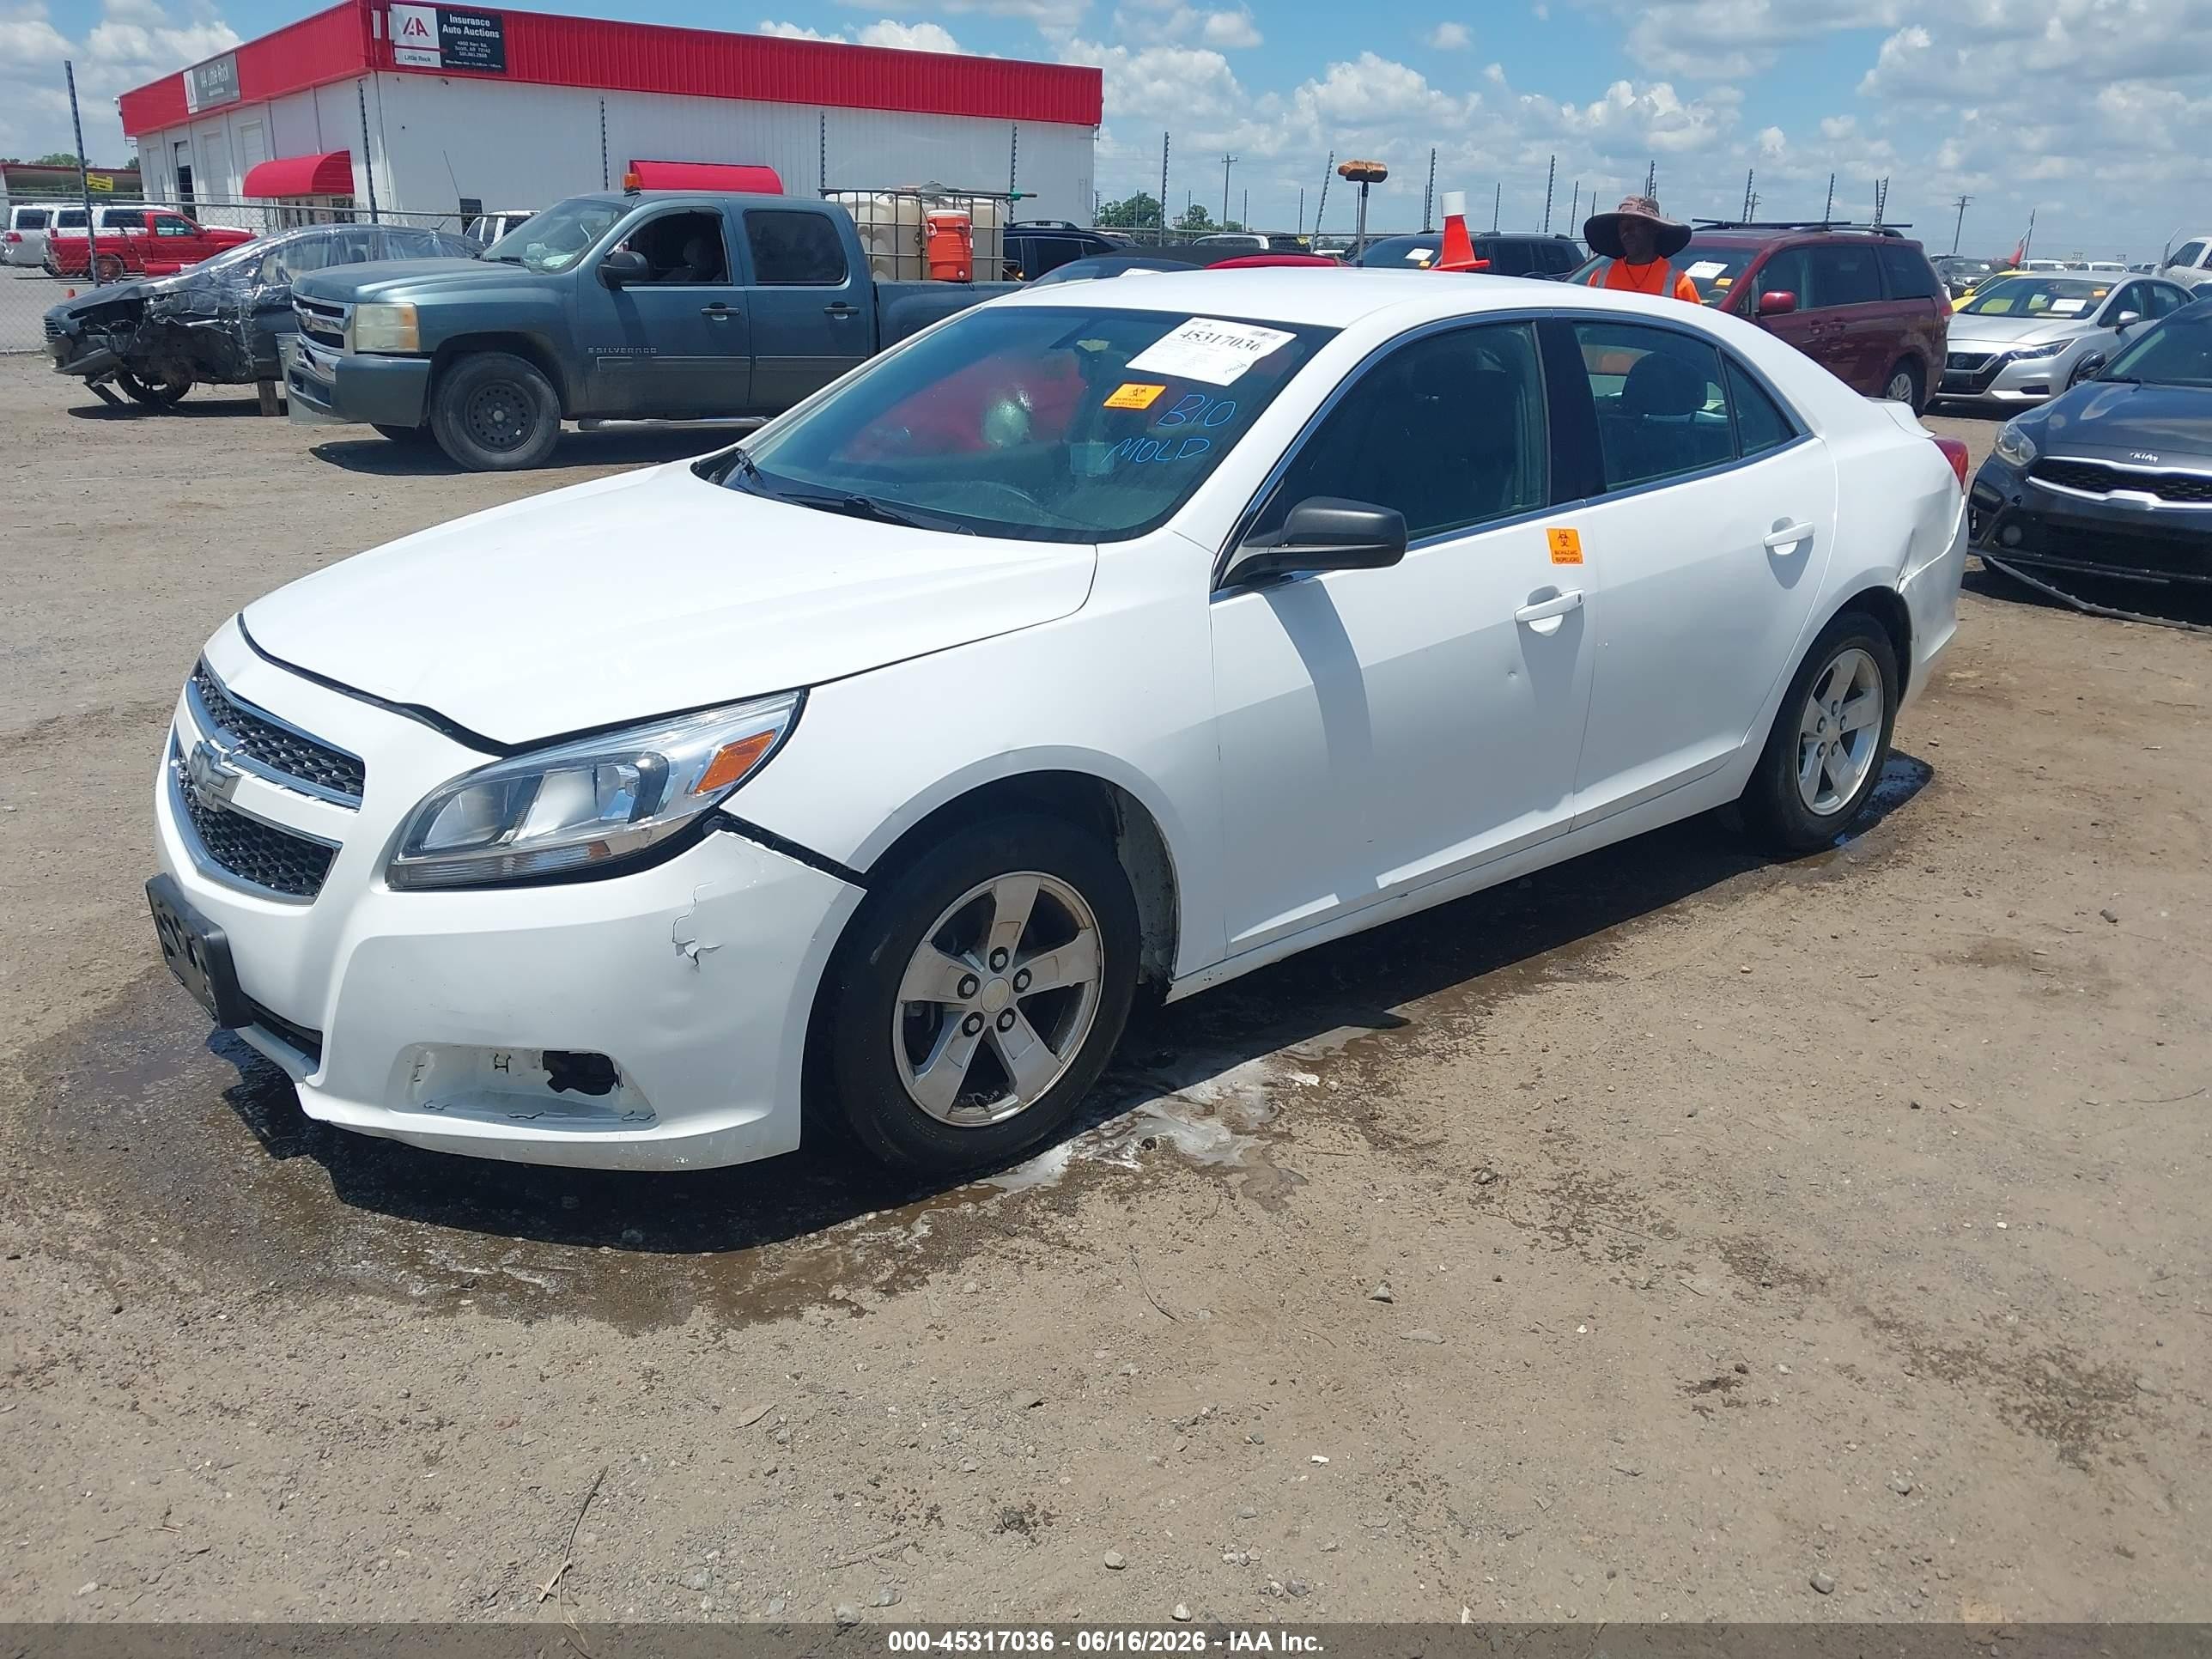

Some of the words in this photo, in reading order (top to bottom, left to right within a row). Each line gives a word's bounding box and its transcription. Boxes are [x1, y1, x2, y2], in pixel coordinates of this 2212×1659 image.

[442, 24, 462, 34] Auto
[464, 26, 500, 38] Auctions
[449, 14, 490, 27] Insurance
[1179, 330, 1261, 352] 45317036
[1156, 394, 1237, 427] BIO
[1101, 437, 1210, 464] MOLD
